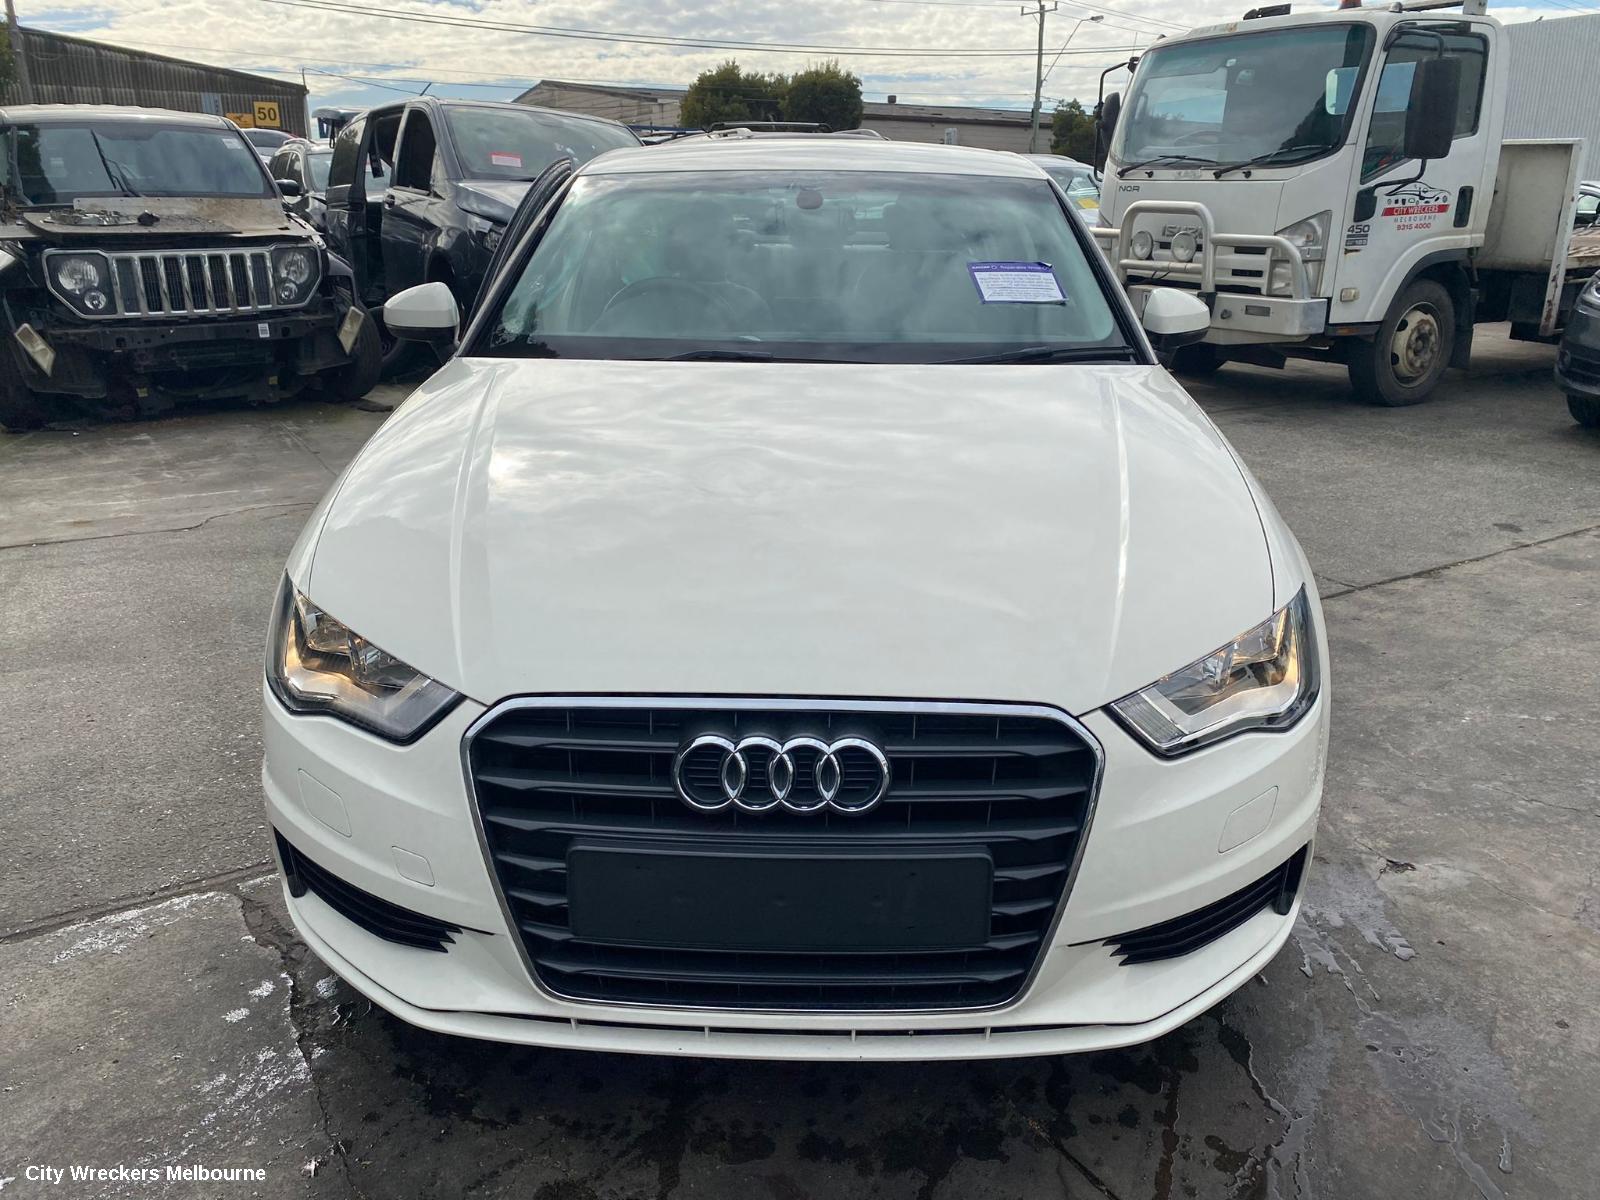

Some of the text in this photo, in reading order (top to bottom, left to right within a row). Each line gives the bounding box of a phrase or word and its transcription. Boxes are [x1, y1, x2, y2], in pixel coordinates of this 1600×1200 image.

[257, 106, 277, 121] 50
[1393, 204, 1439, 216] CITY WRECKERS
[1394, 214, 1437, 223] MELBOURNE
[1347, 224, 1370, 234] 450
[1414, 222, 1431, 230] 4000
